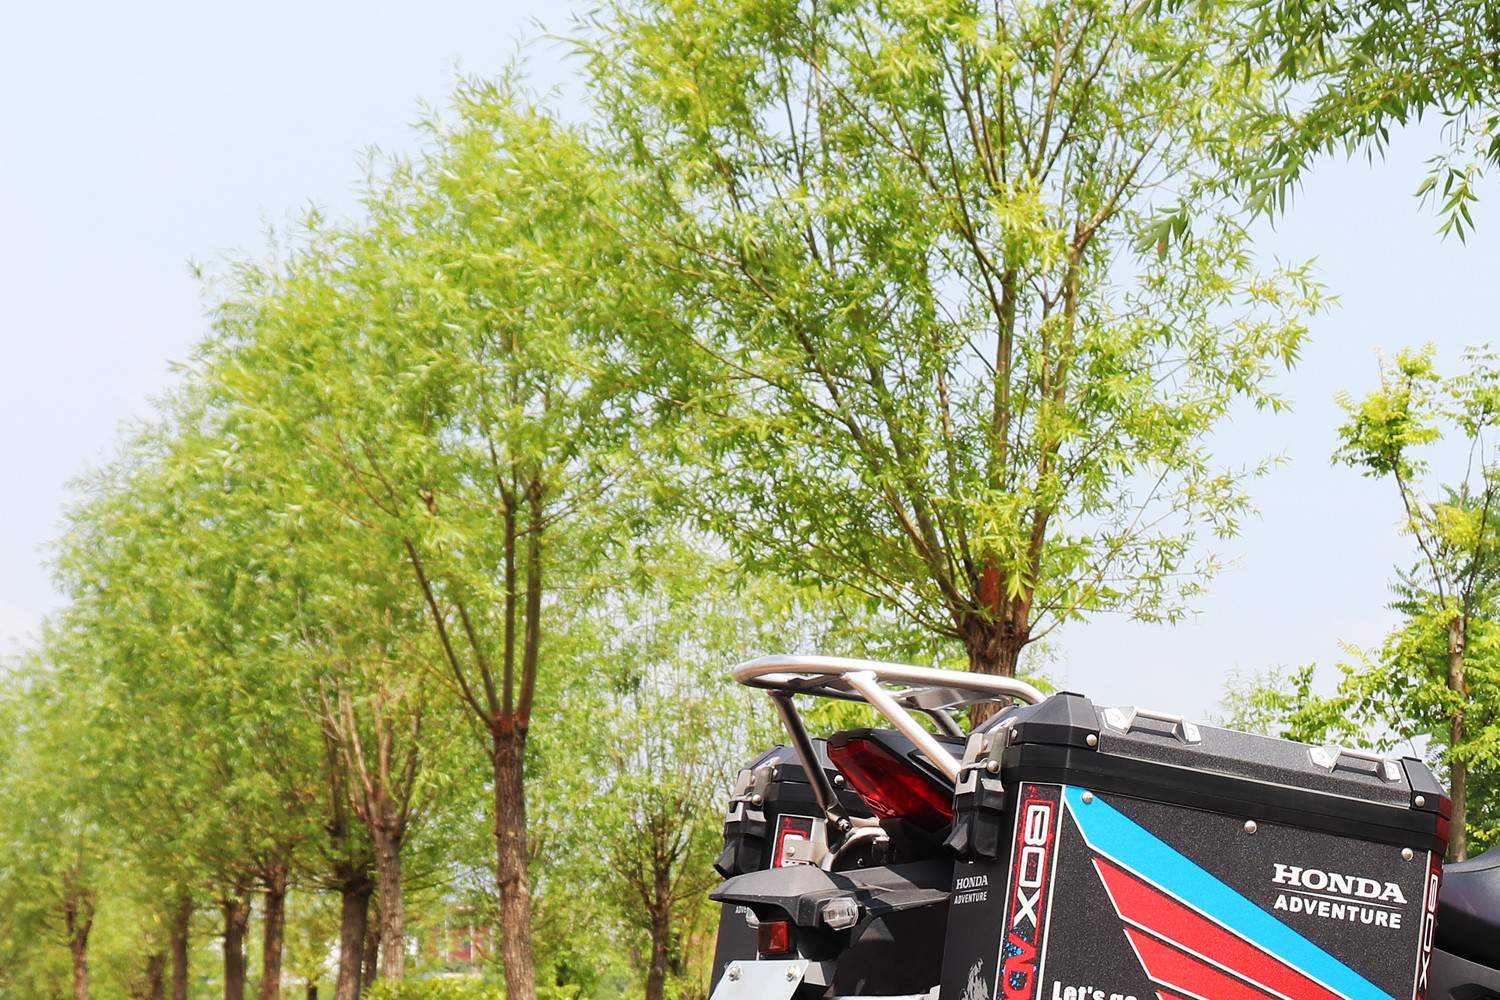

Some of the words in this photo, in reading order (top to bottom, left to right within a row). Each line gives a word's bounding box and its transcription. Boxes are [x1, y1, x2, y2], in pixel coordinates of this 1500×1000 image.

[955, 874, 989, 890] HONDA
[1271, 862, 1408, 905] HONDA
[953, 891, 988, 905] ADVENTURE
[1273, 893, 1403, 930] ADVENTURE
